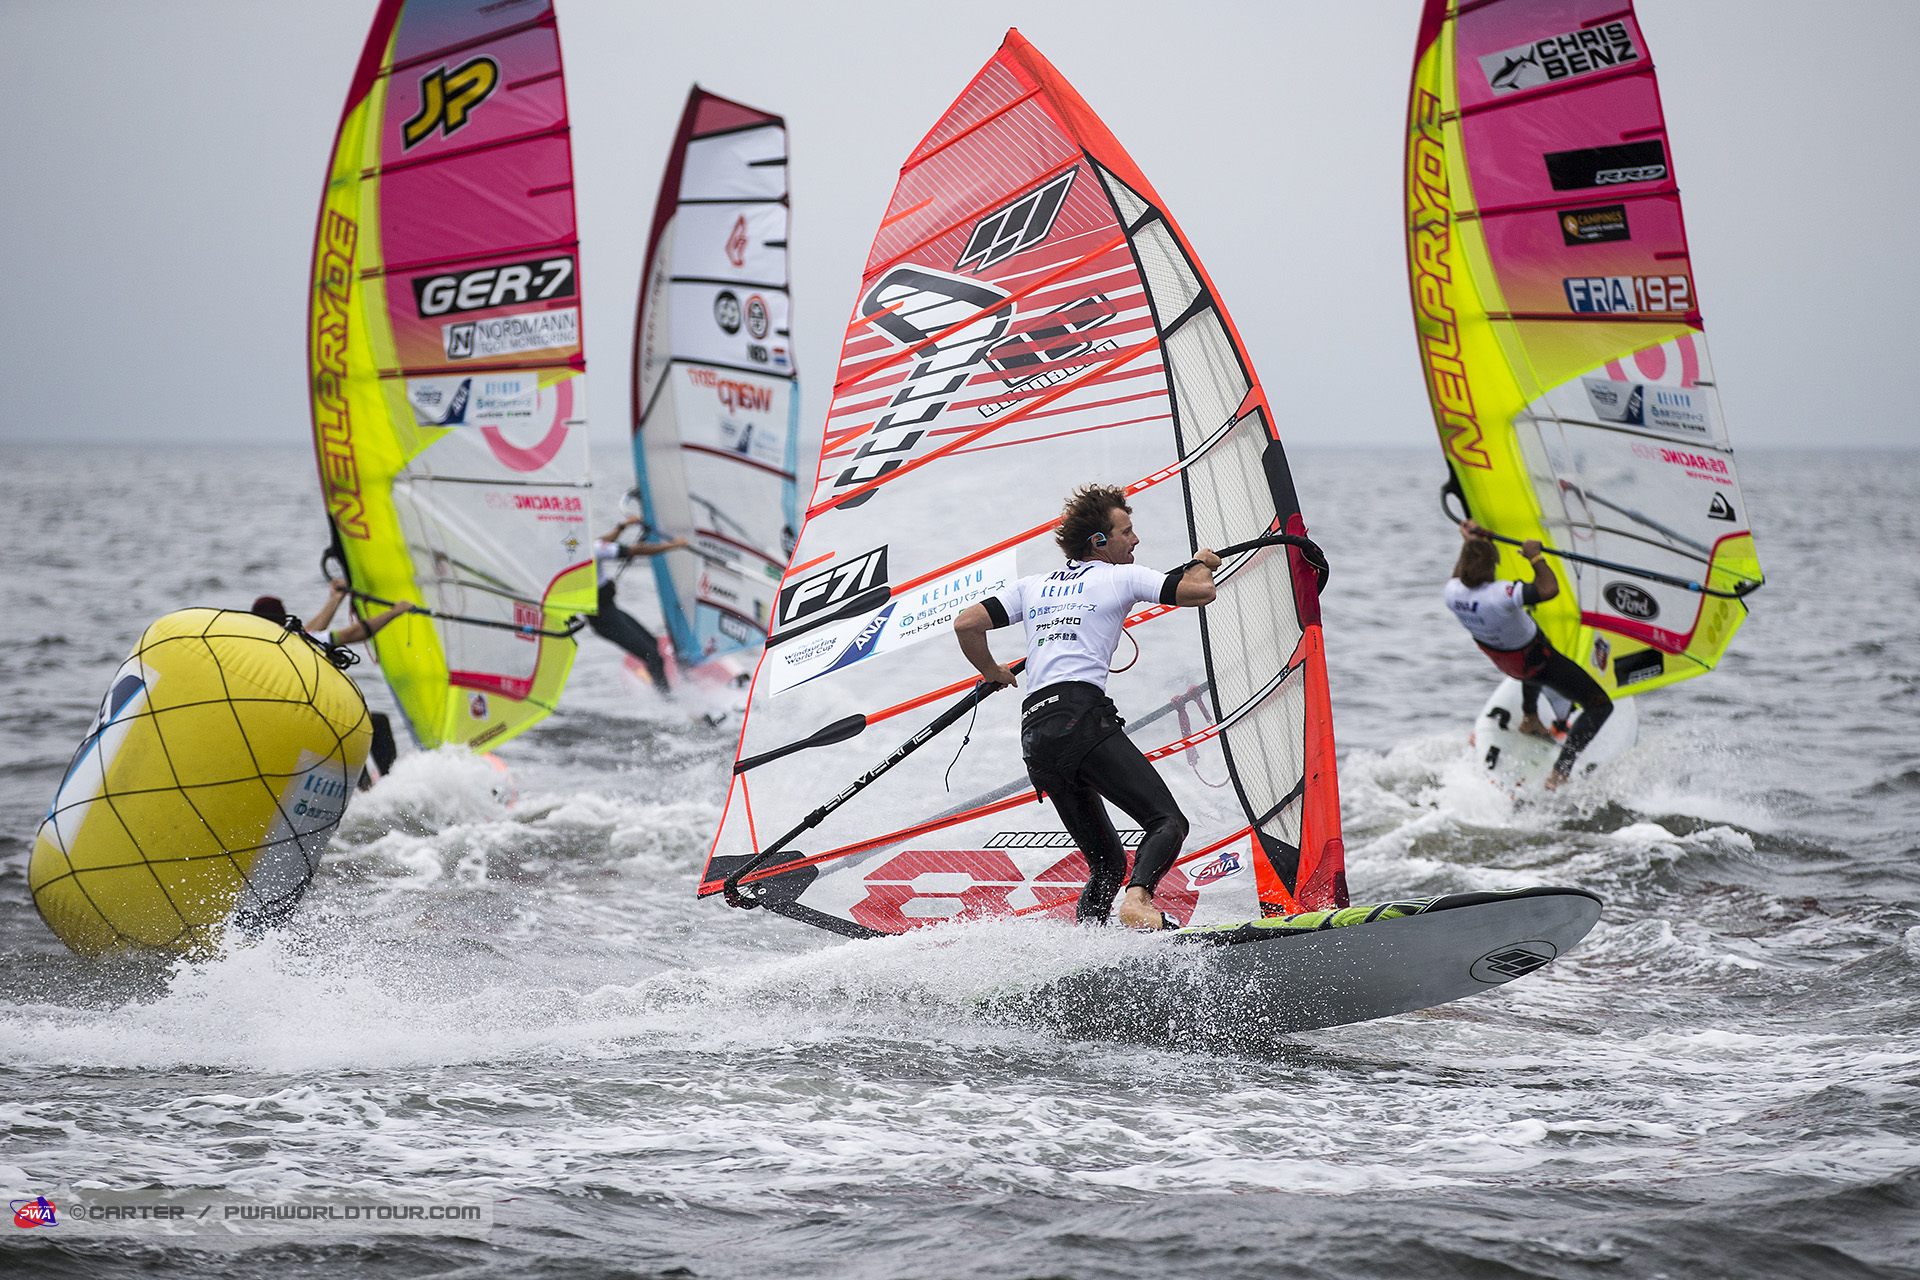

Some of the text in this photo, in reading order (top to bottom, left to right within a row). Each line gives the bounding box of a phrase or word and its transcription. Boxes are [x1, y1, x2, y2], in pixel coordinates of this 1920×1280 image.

[1536, 21, 1628, 59] CHRIS
[1542, 41, 1639, 80] BENZ
[402, 55, 499, 152] JP
[1595, 165, 1666, 185] RRD
[1411, 88, 1492, 470] NEILPRYDE
[479, 314, 575, 340] NORDMANN
[315, 210, 370, 539] NEILPRYDE
[784, 549, 883, 622] F71
[921, 569, 983, 606] KEIKYU
[1041, 582, 1084, 598] KEIKYU
[1615, 585, 1650, 616] Ford
[854, 616, 889, 651] ANA
[899, 614, 952, 639] アサヒドライゼロ
[784, 637, 837, 660] Windsurfing
[787, 650, 814, 665] World
[816, 644, 834, 656] Cup
[823, 726, 933, 811] SEVERNE
